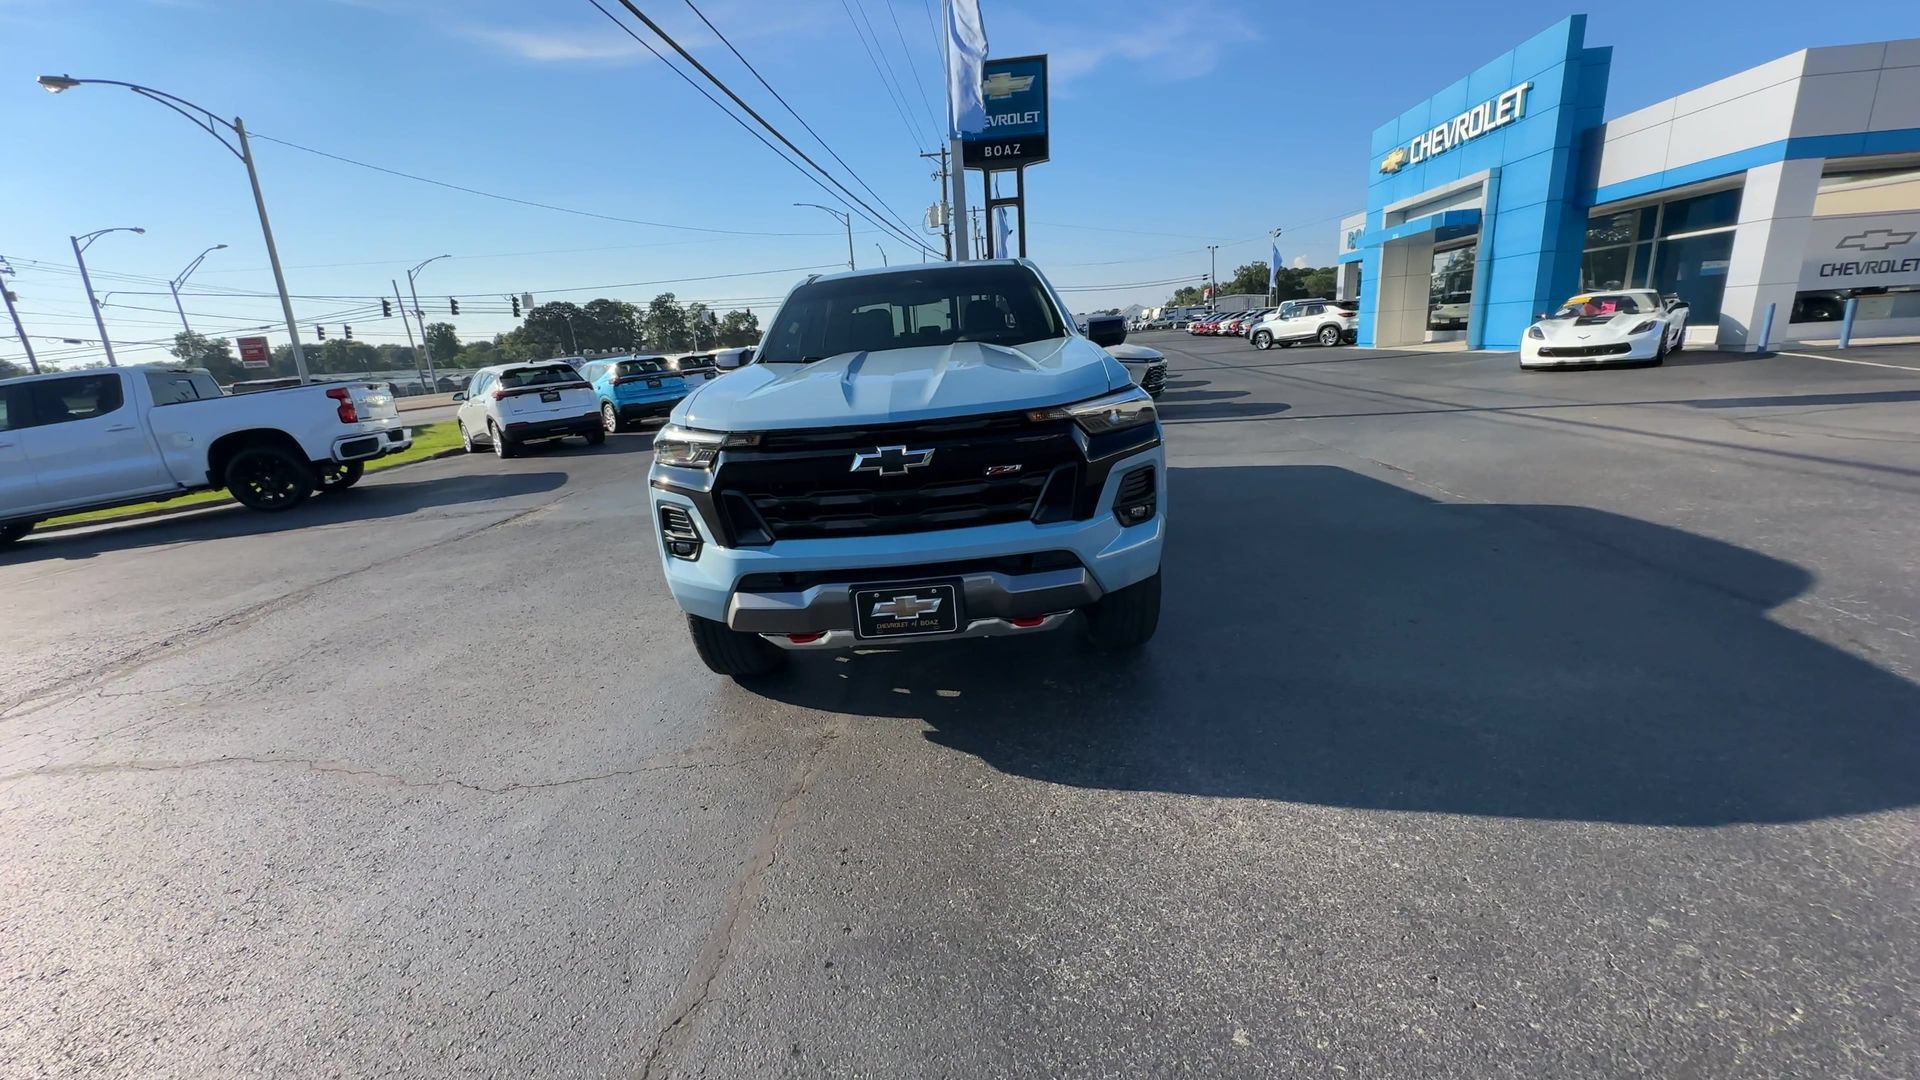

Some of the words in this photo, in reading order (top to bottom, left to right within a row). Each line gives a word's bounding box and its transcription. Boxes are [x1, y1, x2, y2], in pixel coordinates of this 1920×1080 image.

[984, 110, 1040, 128] EVROLET
[1410, 81, 1530, 164] CHEVROLET
[984, 143, 1021, 157] BOAZ
[1820, 258, 1920, 277] CHEVROLET
[876, 621, 908, 630] CHEVROLET
